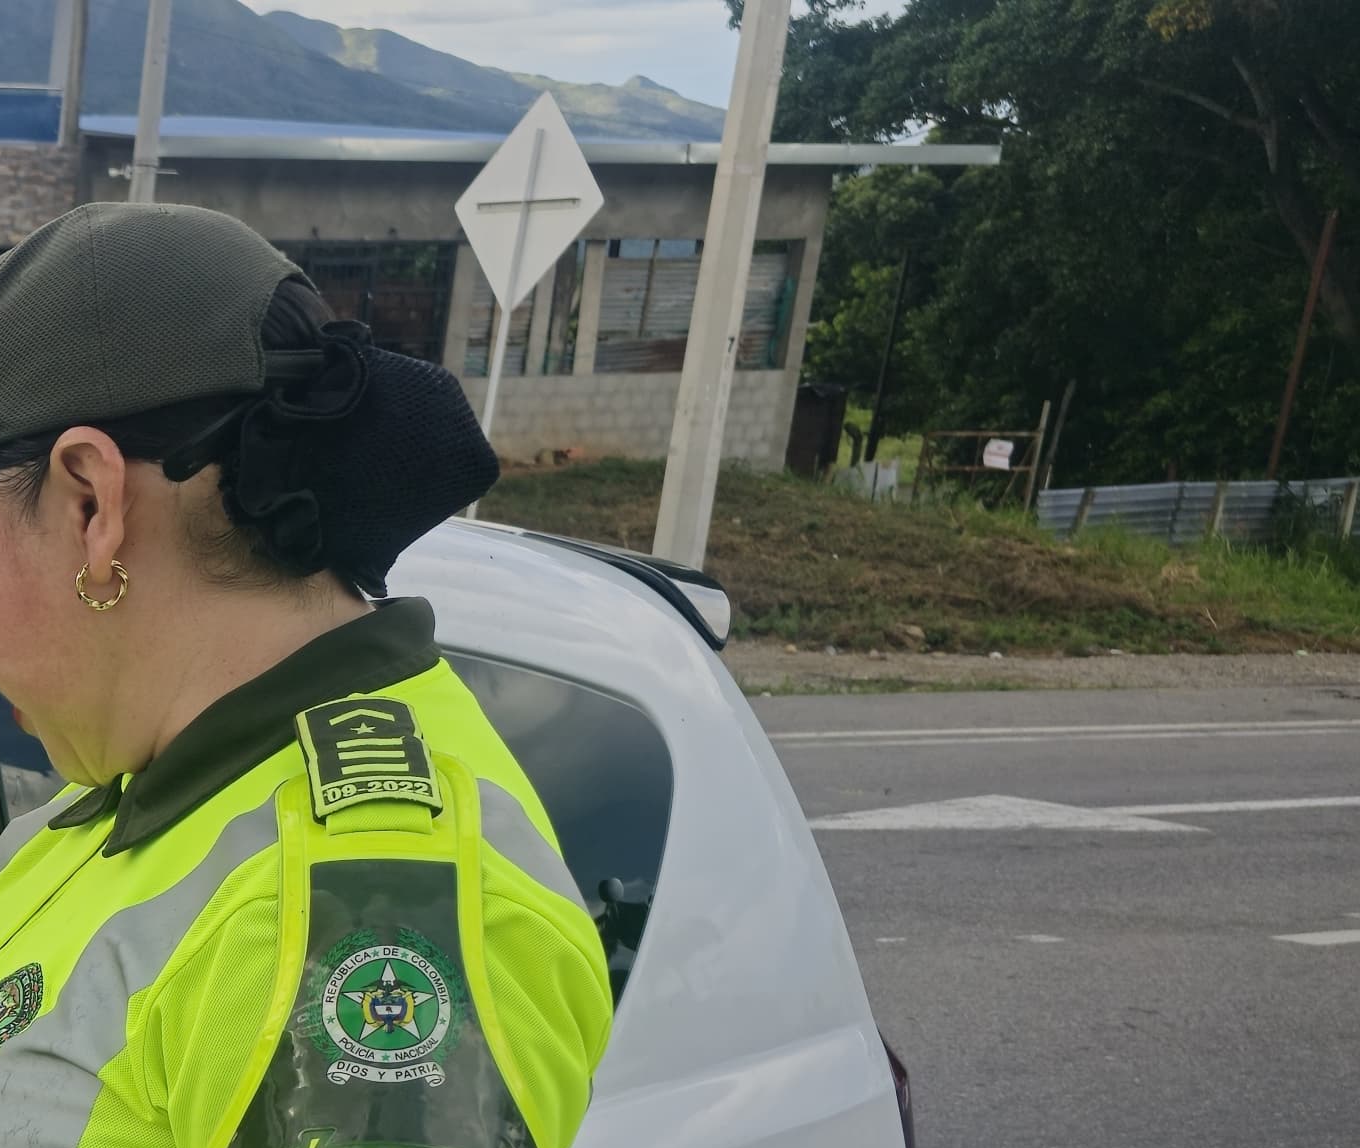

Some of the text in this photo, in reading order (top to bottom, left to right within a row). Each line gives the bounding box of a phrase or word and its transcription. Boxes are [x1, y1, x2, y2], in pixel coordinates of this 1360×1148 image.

[324, 780, 430, 804] 09-2022
[383, 947, 399, 956] DE
[411, 955, 449, 1005] COLOMBIA
[395, 1037, 439, 1061] NACIONAL
[336, 1061, 440, 1080] DIOS Y PATRIA
